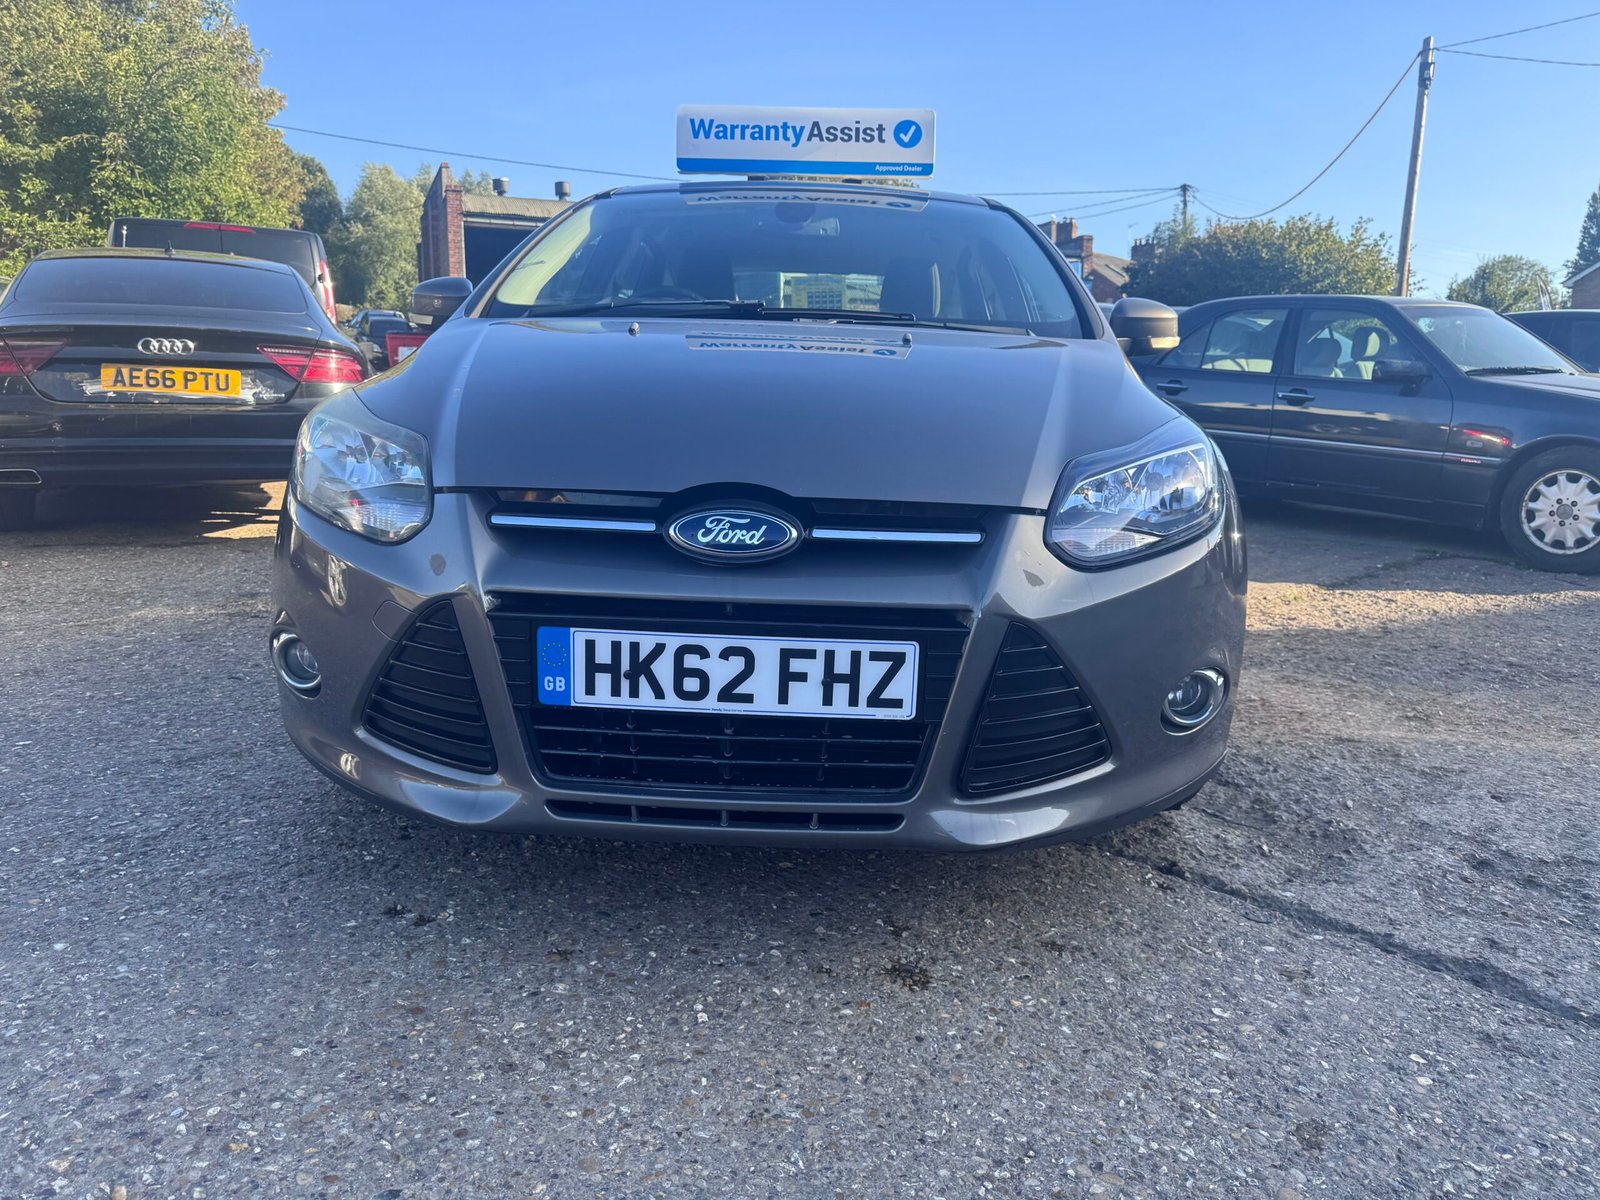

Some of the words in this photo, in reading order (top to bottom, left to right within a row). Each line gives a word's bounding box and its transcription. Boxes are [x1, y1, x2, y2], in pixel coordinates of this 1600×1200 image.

[875, 164, 903, 172] Approved
[112, 366, 176, 389] AE66
[183, 370, 230, 392] PTU
[697, 515, 768, 545] Ford
[543, 675, 566, 692] GB
[584, 638, 756, 704] HK62
[777, 647, 907, 710] FHZ
